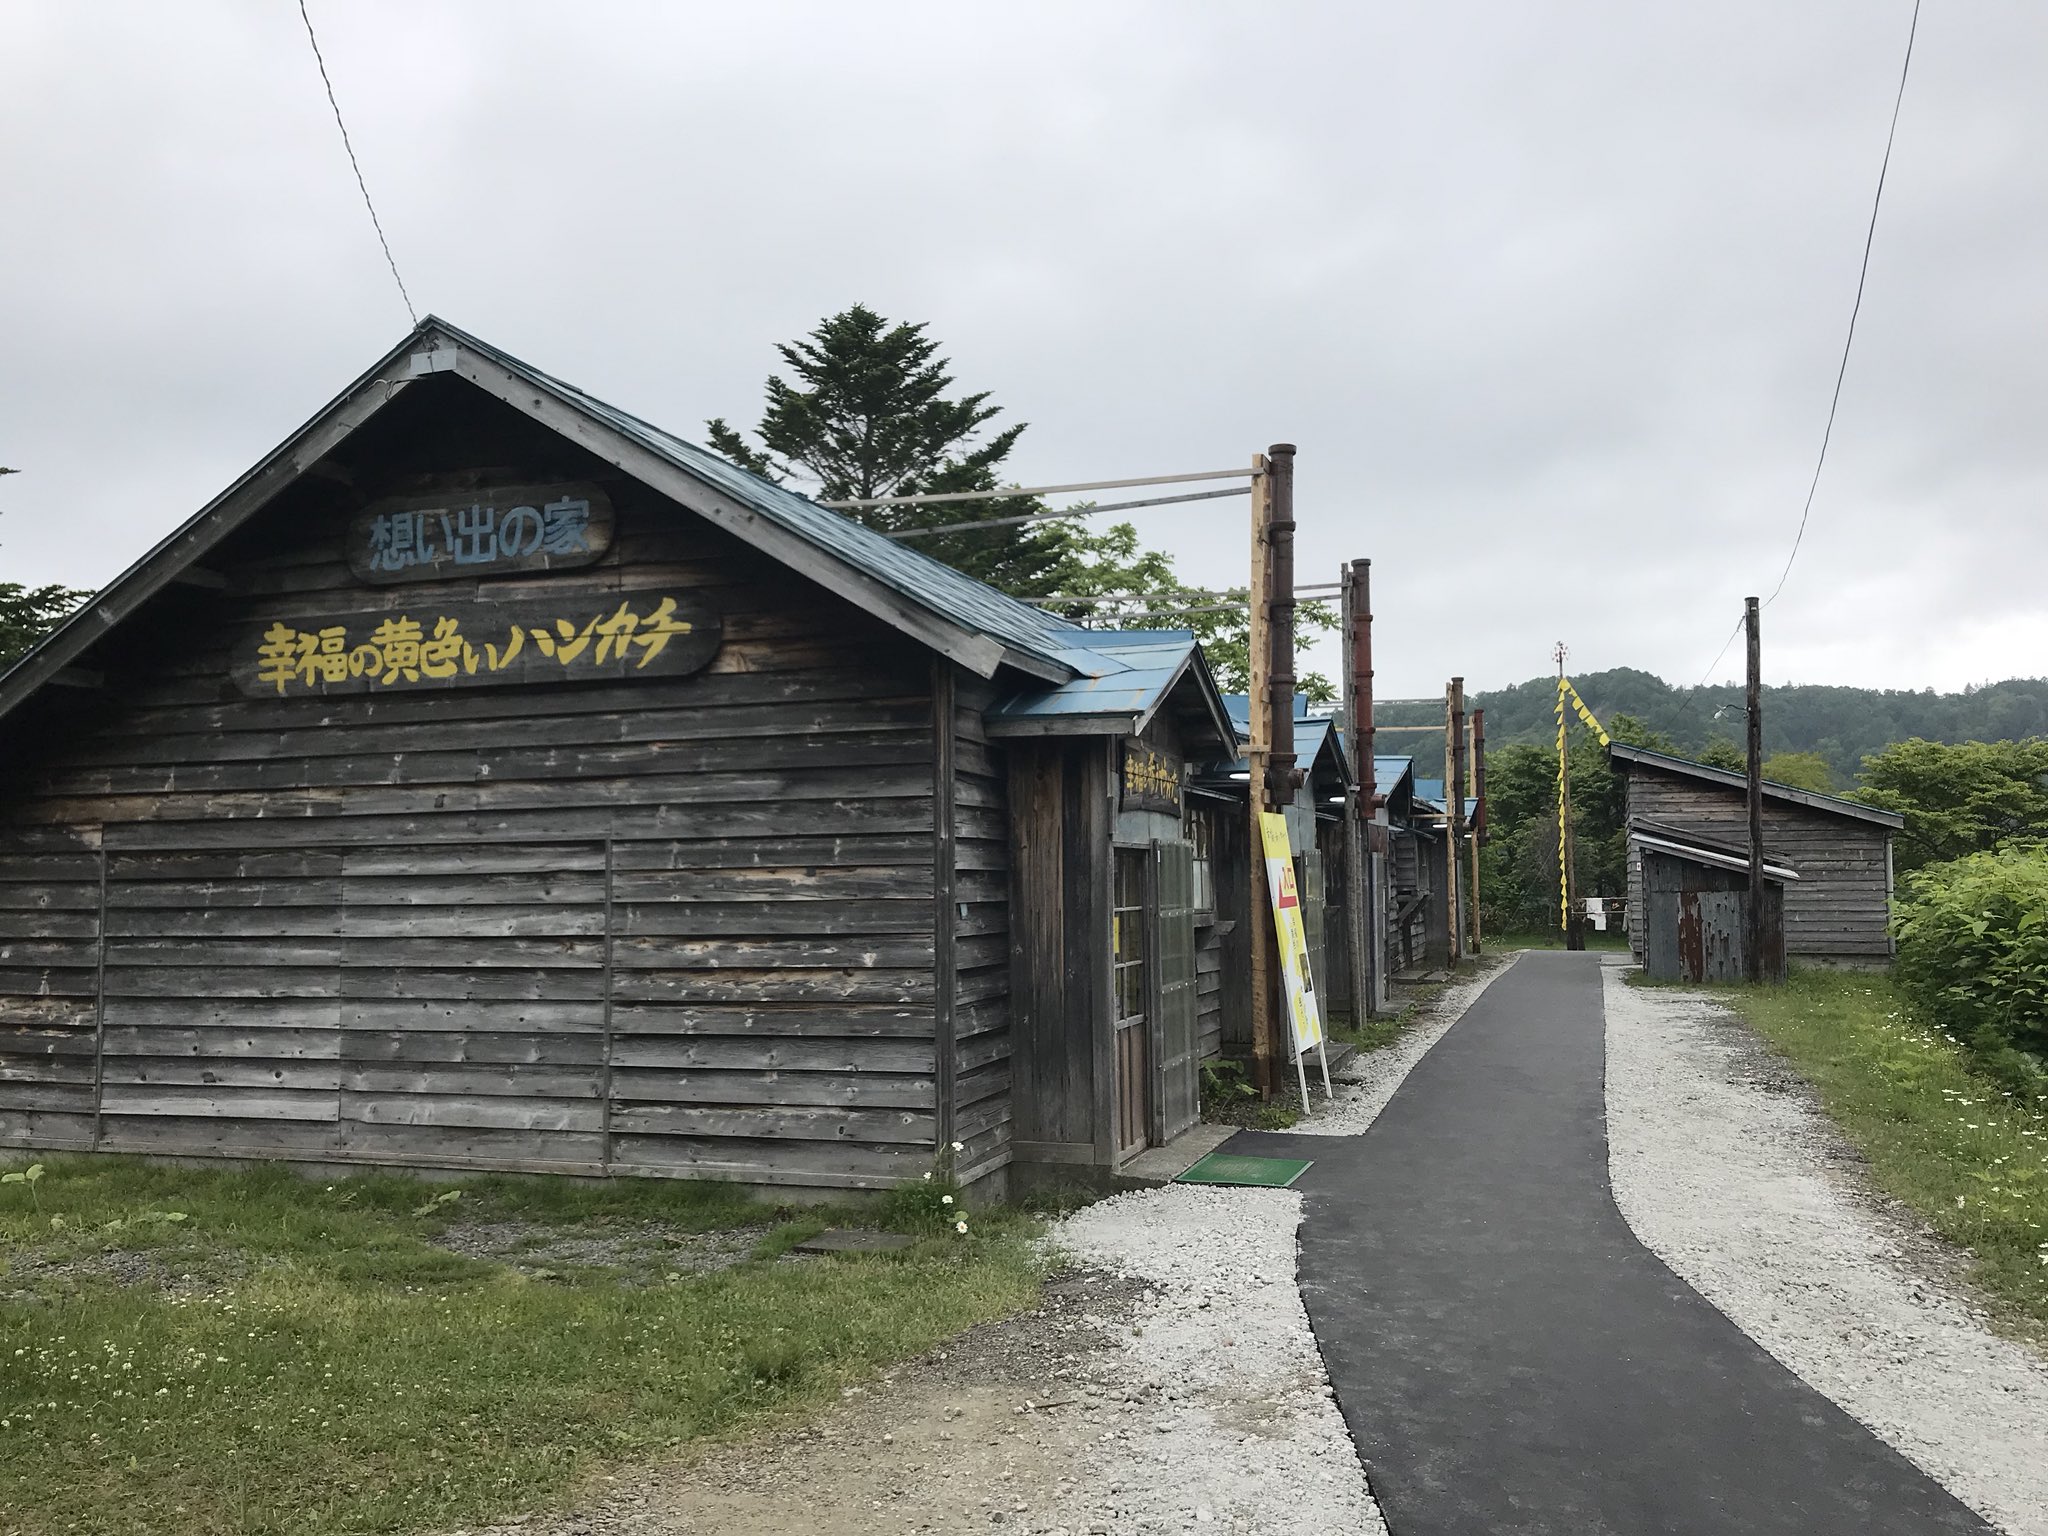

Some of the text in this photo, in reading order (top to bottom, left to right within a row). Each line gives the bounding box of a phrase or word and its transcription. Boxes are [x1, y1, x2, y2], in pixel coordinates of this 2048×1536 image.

[368, 495, 590, 572] 想い出の家
[257, 597, 694, 695] 幸福の黄色いハンカチ
